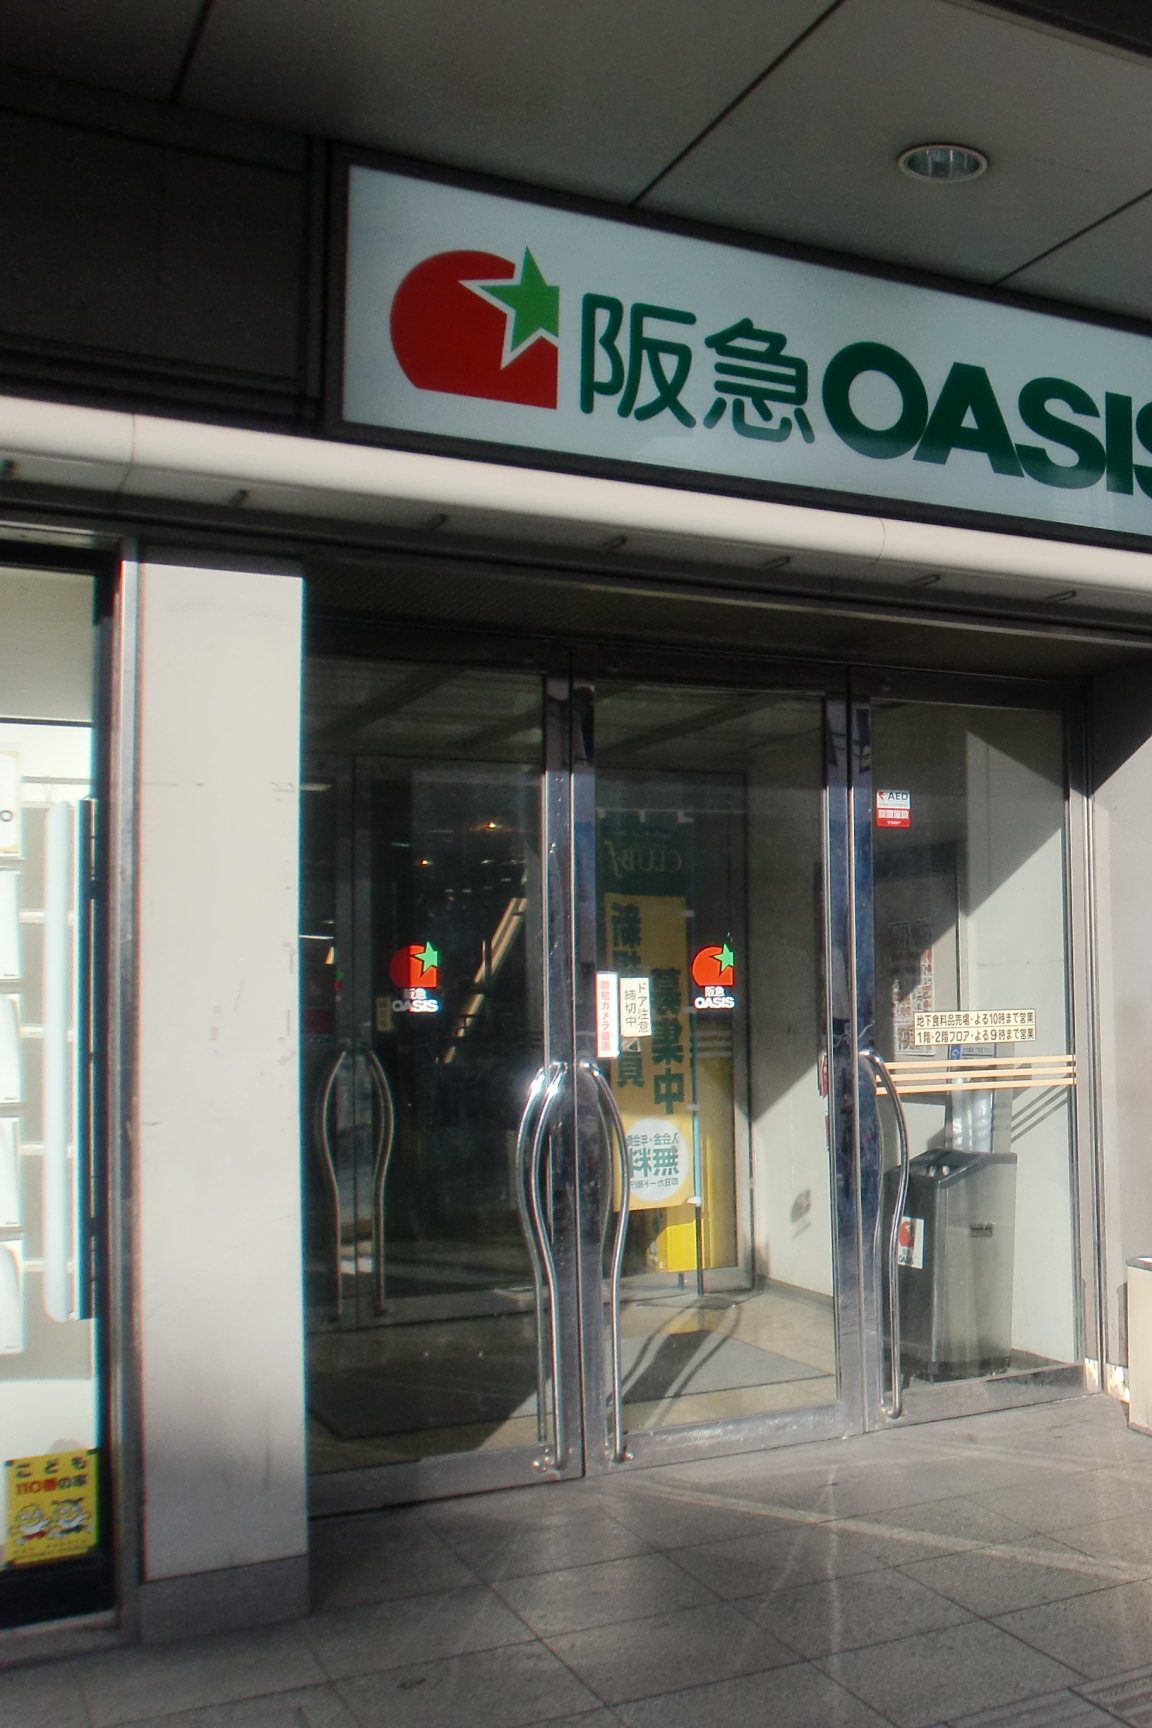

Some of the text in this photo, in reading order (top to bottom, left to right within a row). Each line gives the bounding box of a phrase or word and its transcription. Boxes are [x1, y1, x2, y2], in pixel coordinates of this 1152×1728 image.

[888, 791, 909, 801] AED
[392, 999, 440, 1013] OASIS
[638, 982, 650, 1033] ドア注意
[694, 996, 735, 1009] OASIS
